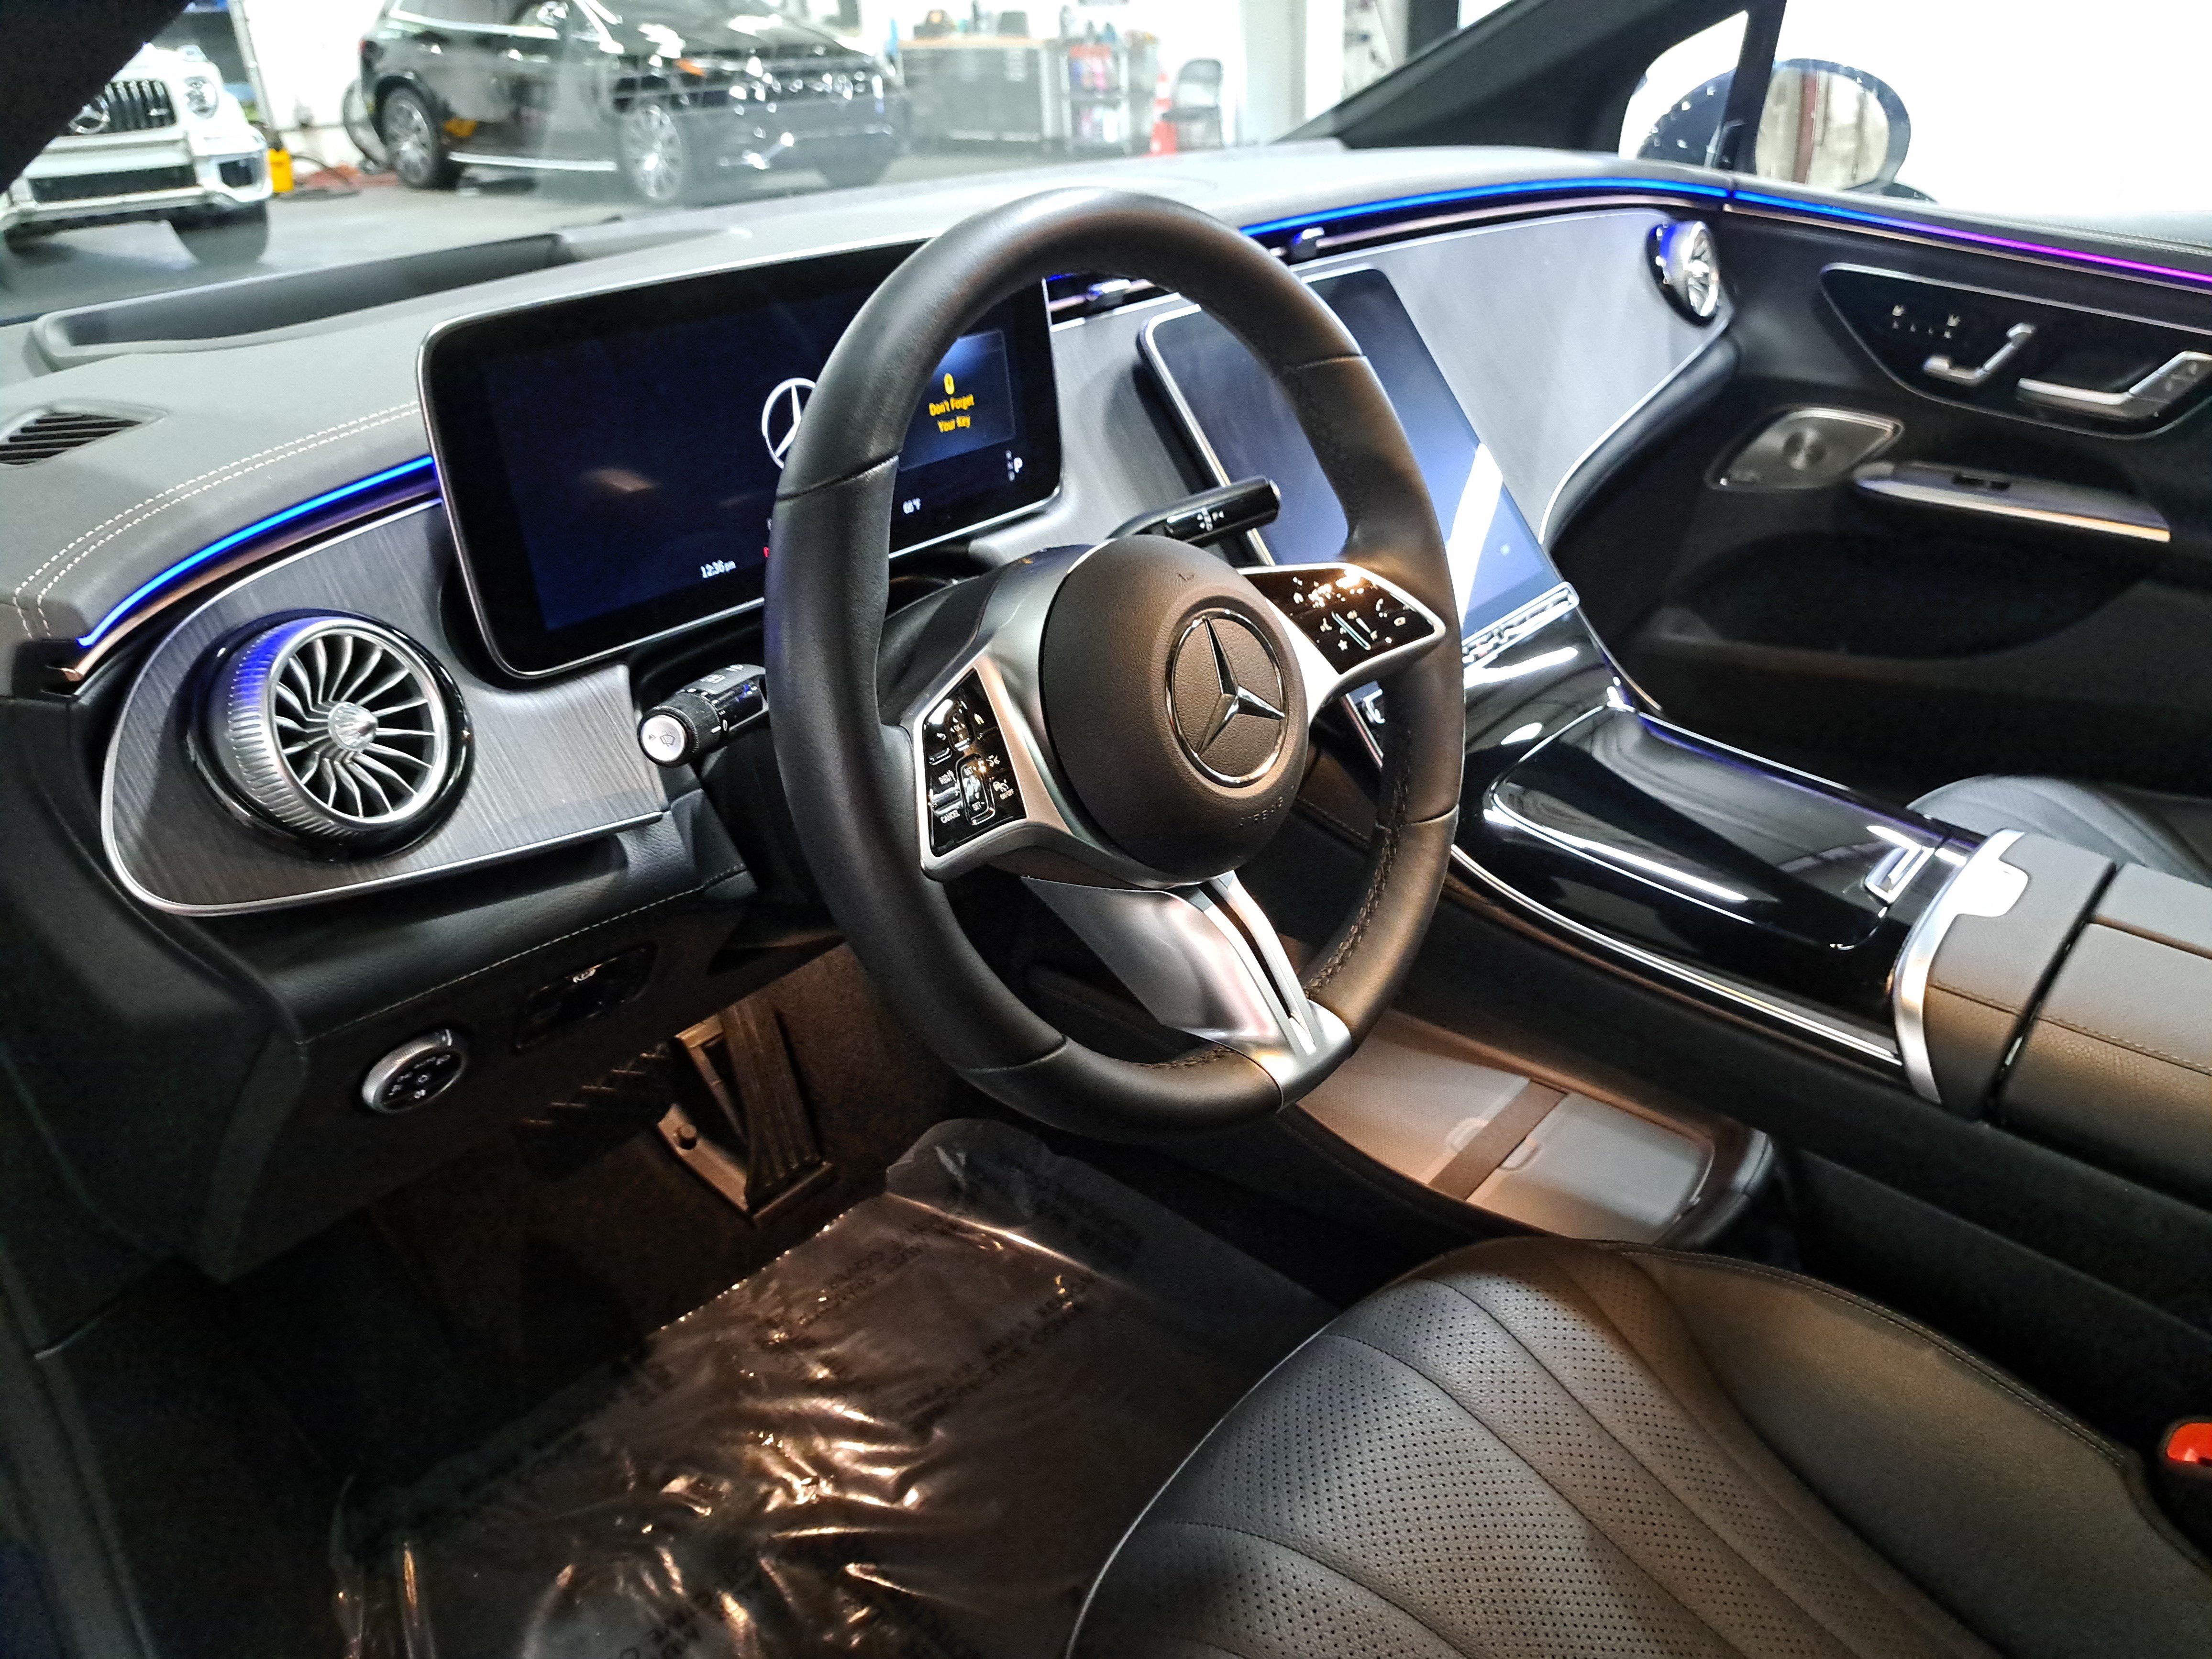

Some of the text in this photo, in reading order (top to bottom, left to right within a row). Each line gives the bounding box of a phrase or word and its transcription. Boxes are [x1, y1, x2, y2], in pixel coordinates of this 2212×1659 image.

[929, 394, 975, 416] Don't Forget
[938, 419, 955, 432] Your
[1013, 457, 1023, 473] P
[940, 809, 961, 824] CANCEL
